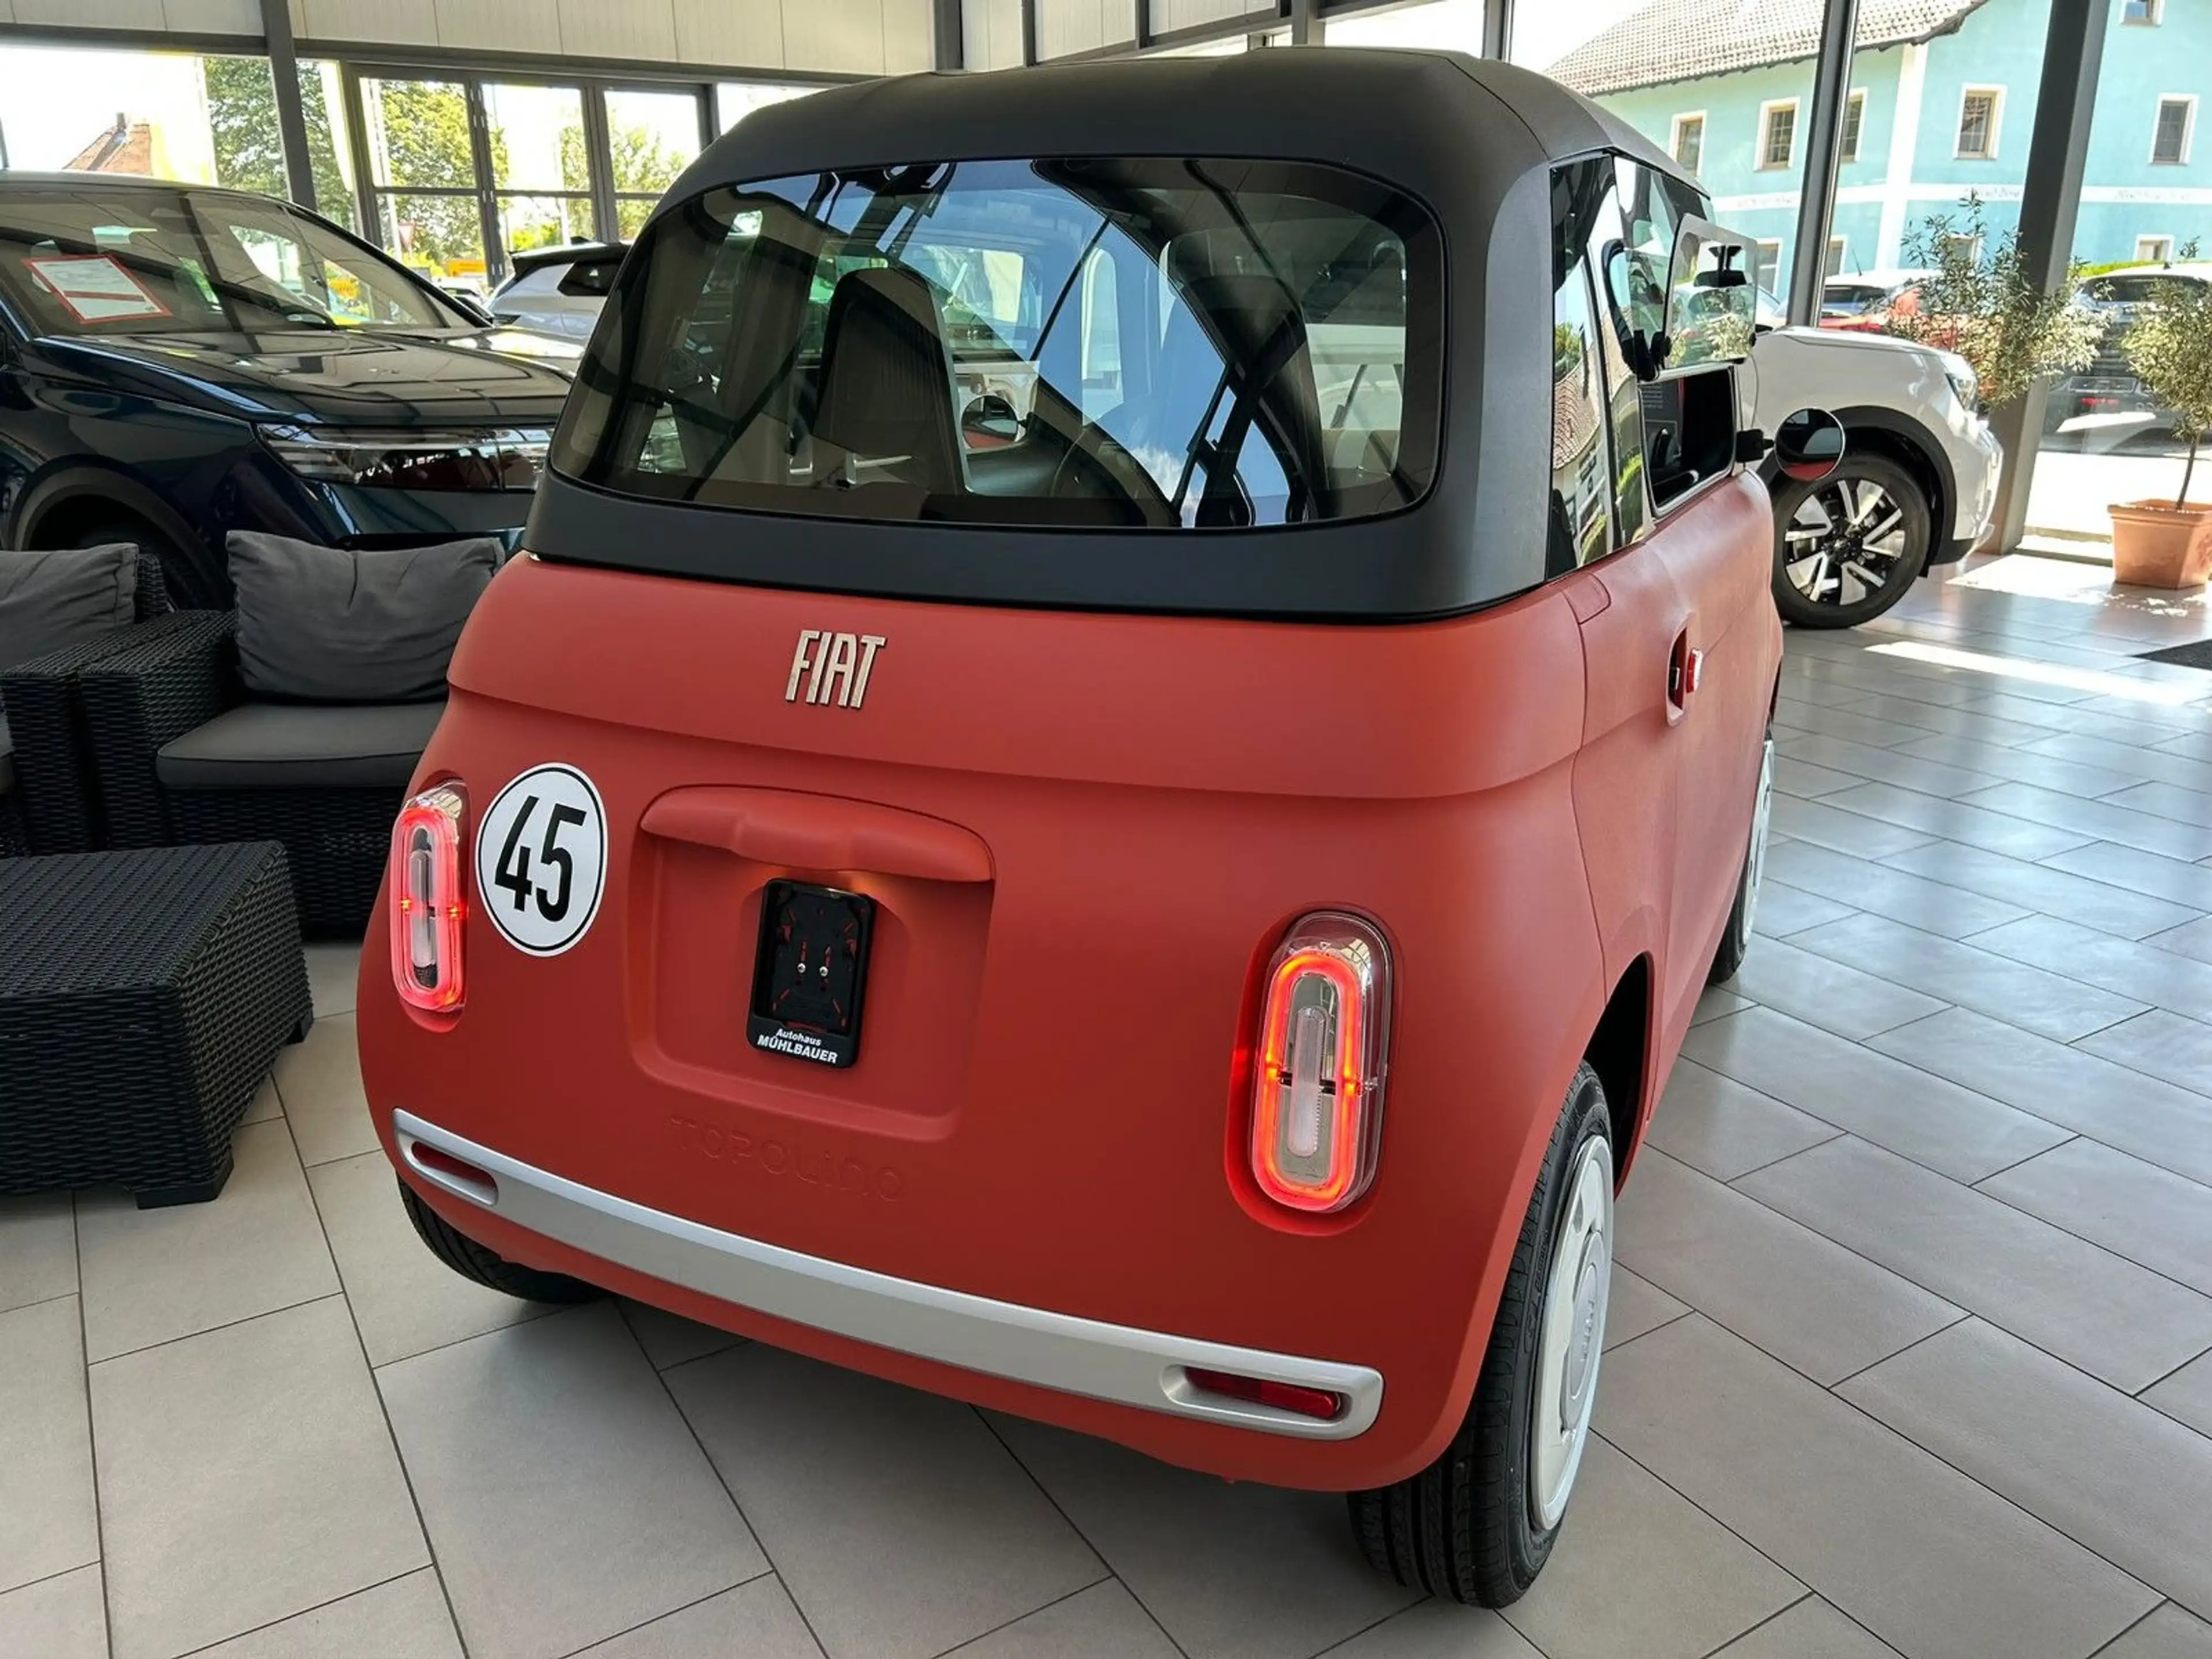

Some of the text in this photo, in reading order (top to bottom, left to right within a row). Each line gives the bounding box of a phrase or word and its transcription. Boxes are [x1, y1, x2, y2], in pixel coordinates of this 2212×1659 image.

[785, 629, 887, 708] FIAT
[495, 795, 587, 922] 45
[757, 1035, 839, 1064] MÜHLBAUER
[776, 1028, 822, 1046] Autohaus
